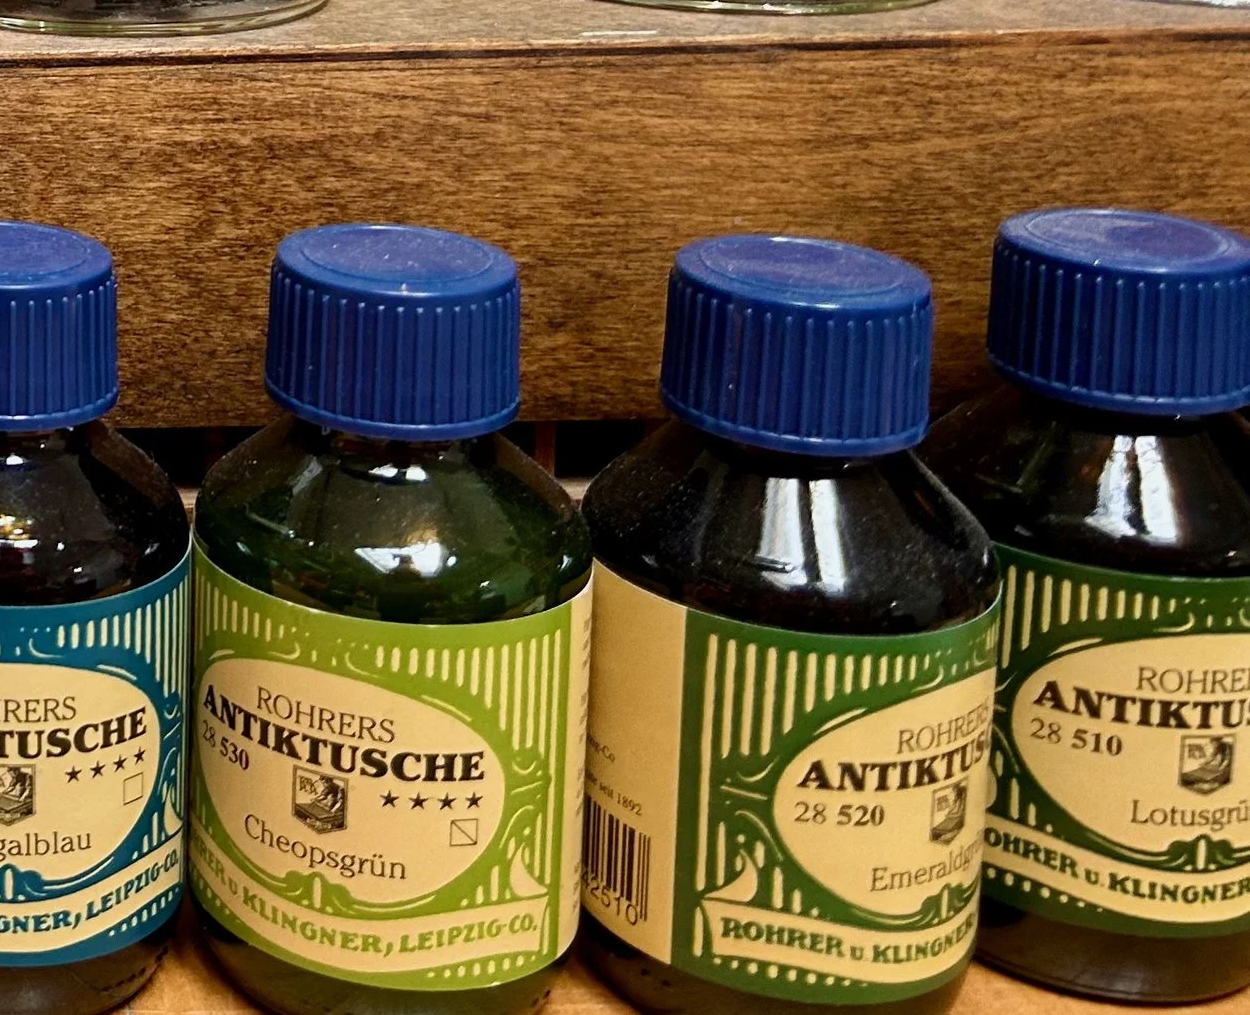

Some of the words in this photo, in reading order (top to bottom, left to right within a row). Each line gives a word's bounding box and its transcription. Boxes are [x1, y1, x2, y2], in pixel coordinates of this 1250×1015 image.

[202, 684, 484, 782] ANTIKTUSCHE
[255, 685, 395, 743] ROHRERS
[1030, 717, 1062, 744] 28
[1071, 728, 1123, 756] 510
[200, 720, 217, 749] 28
[219, 734, 250, 772] 530
[797, 727, 991, 792] ANTIKTUS
[616, 791, 643, 817] 1892
[794, 802, 827, 825] 28
[835, 803, 885, 828] 520
[244, 813, 407, 880] Cheopsgrün
[984, 827, 1079, 880] OHRER
[241, 888, 395, 958] KLINGNER,
[721, 918, 842, 954] ROHRER
